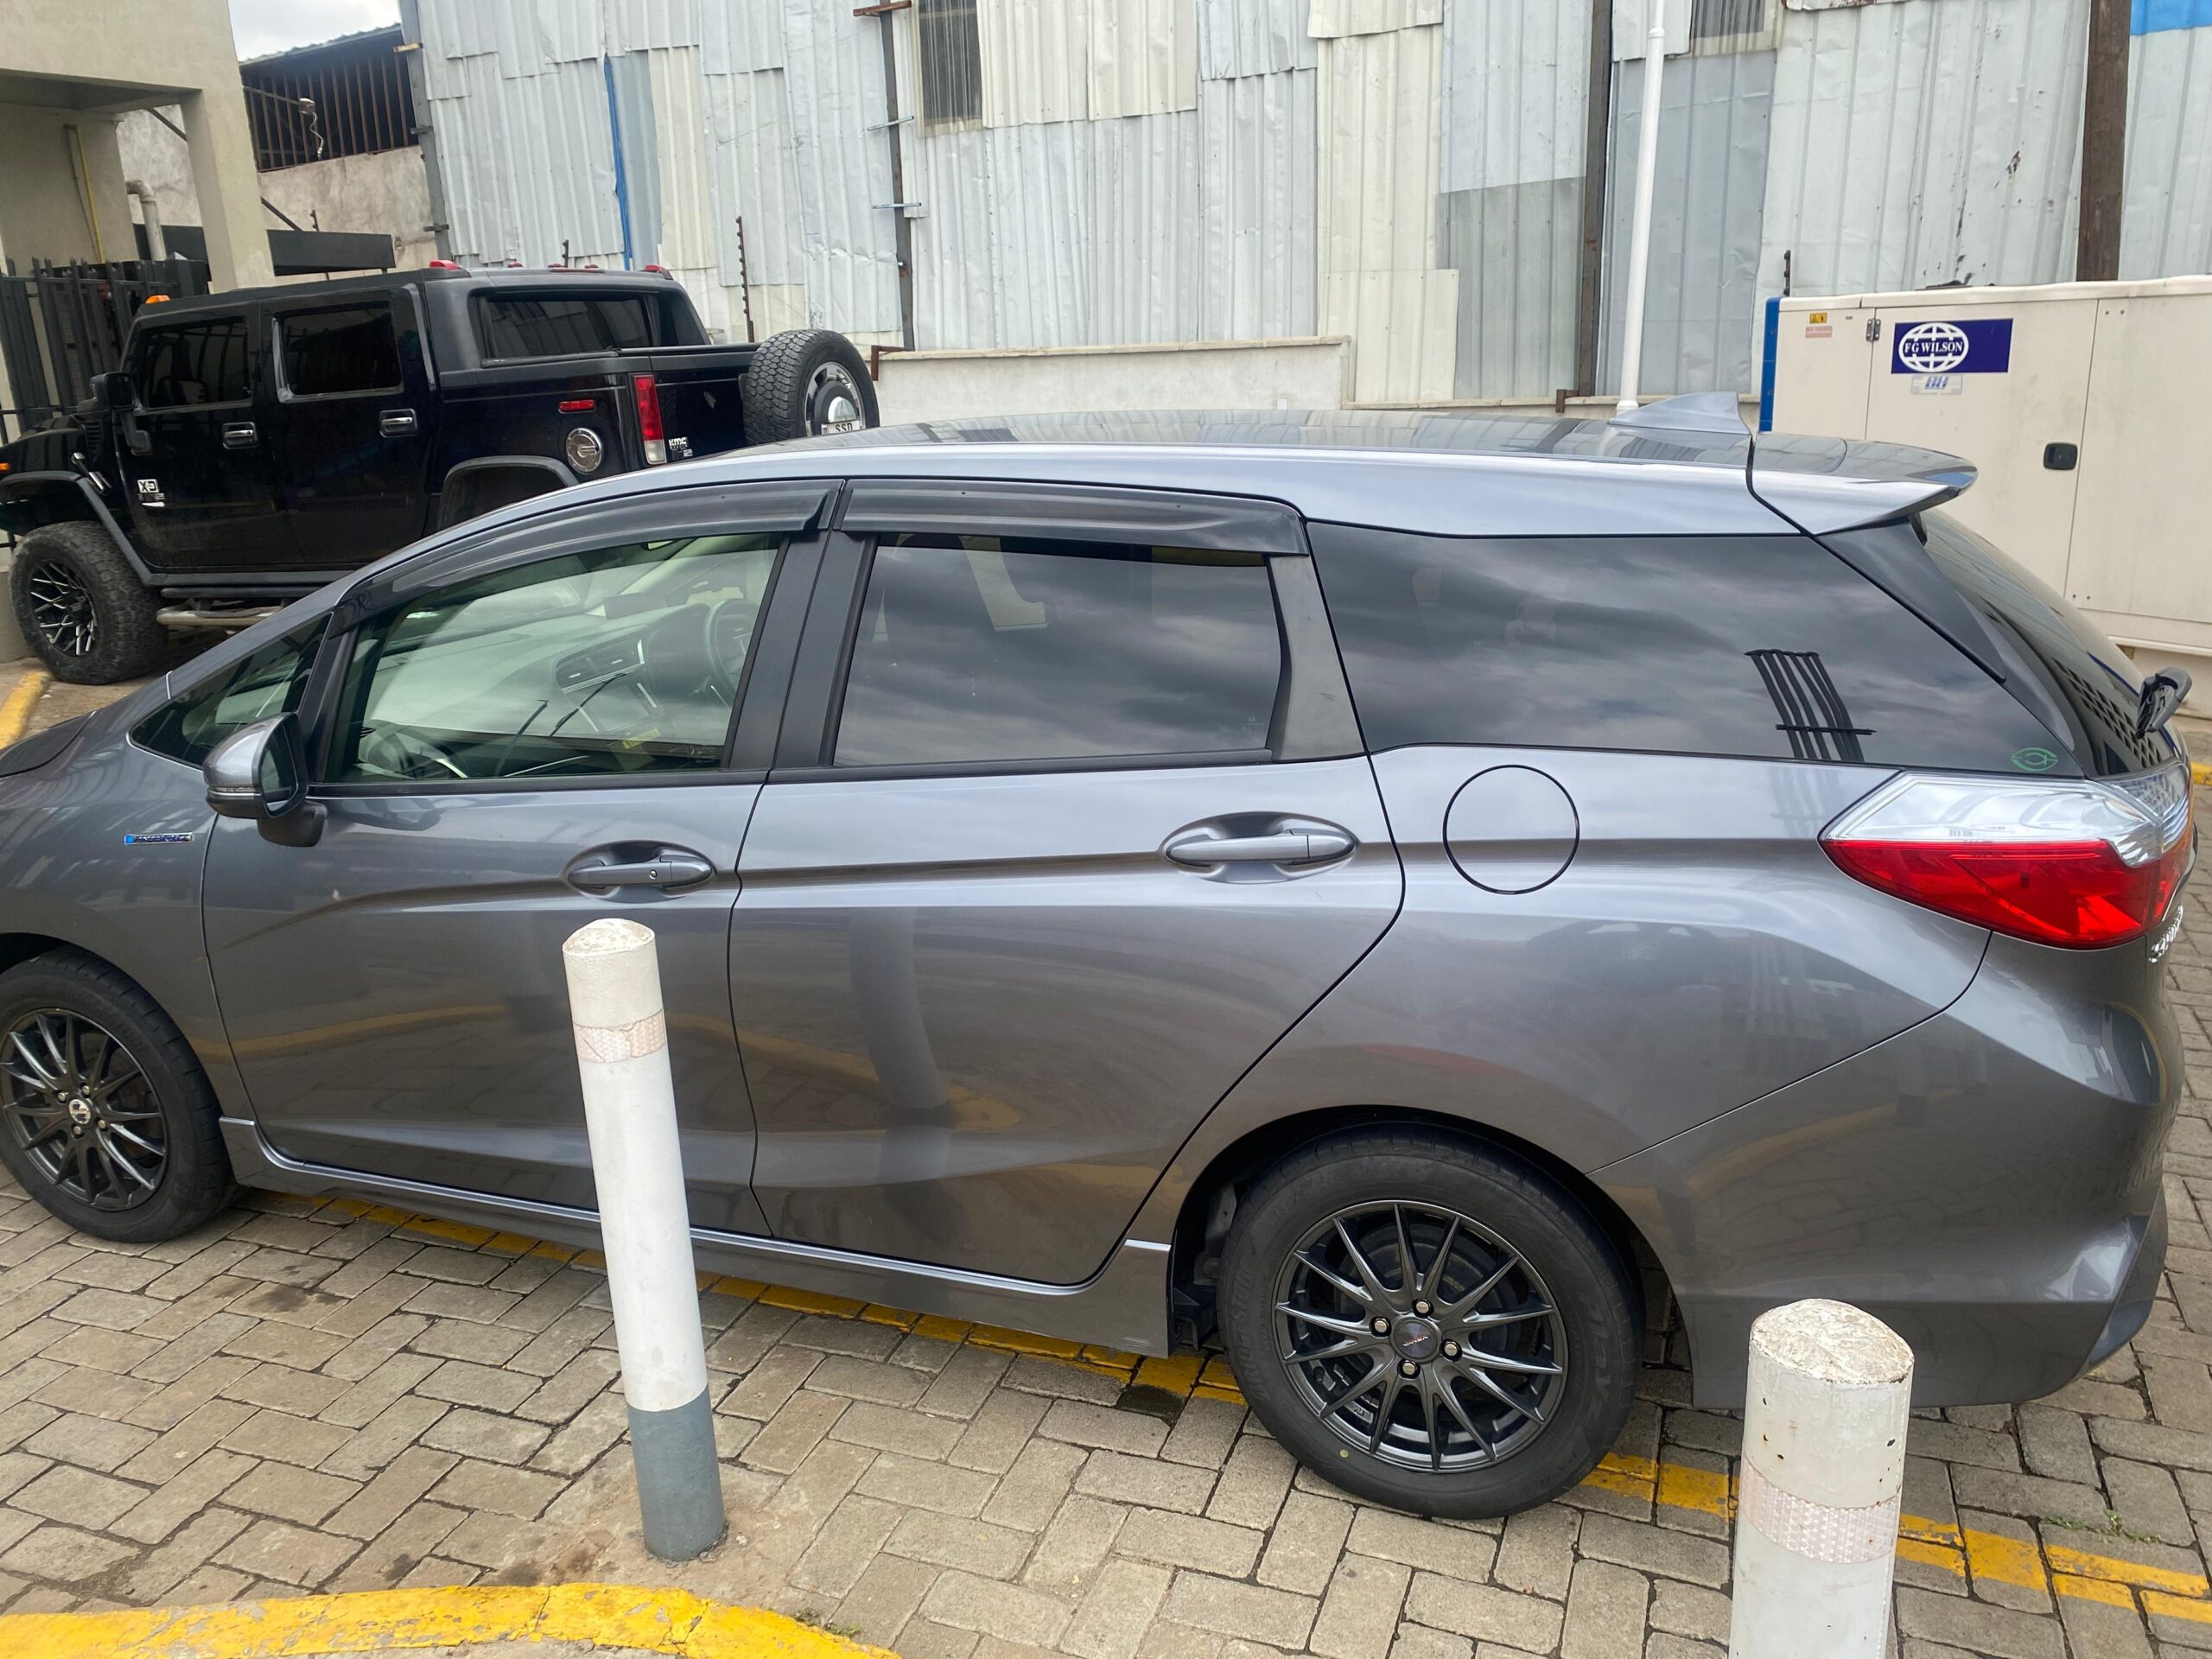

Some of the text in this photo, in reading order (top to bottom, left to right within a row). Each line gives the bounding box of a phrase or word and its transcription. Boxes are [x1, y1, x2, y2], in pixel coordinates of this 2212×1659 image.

[1904, 341, 1963, 353] FG WILSON
[668, 436, 687, 447] KMC
[138, 480, 157, 493] XD
